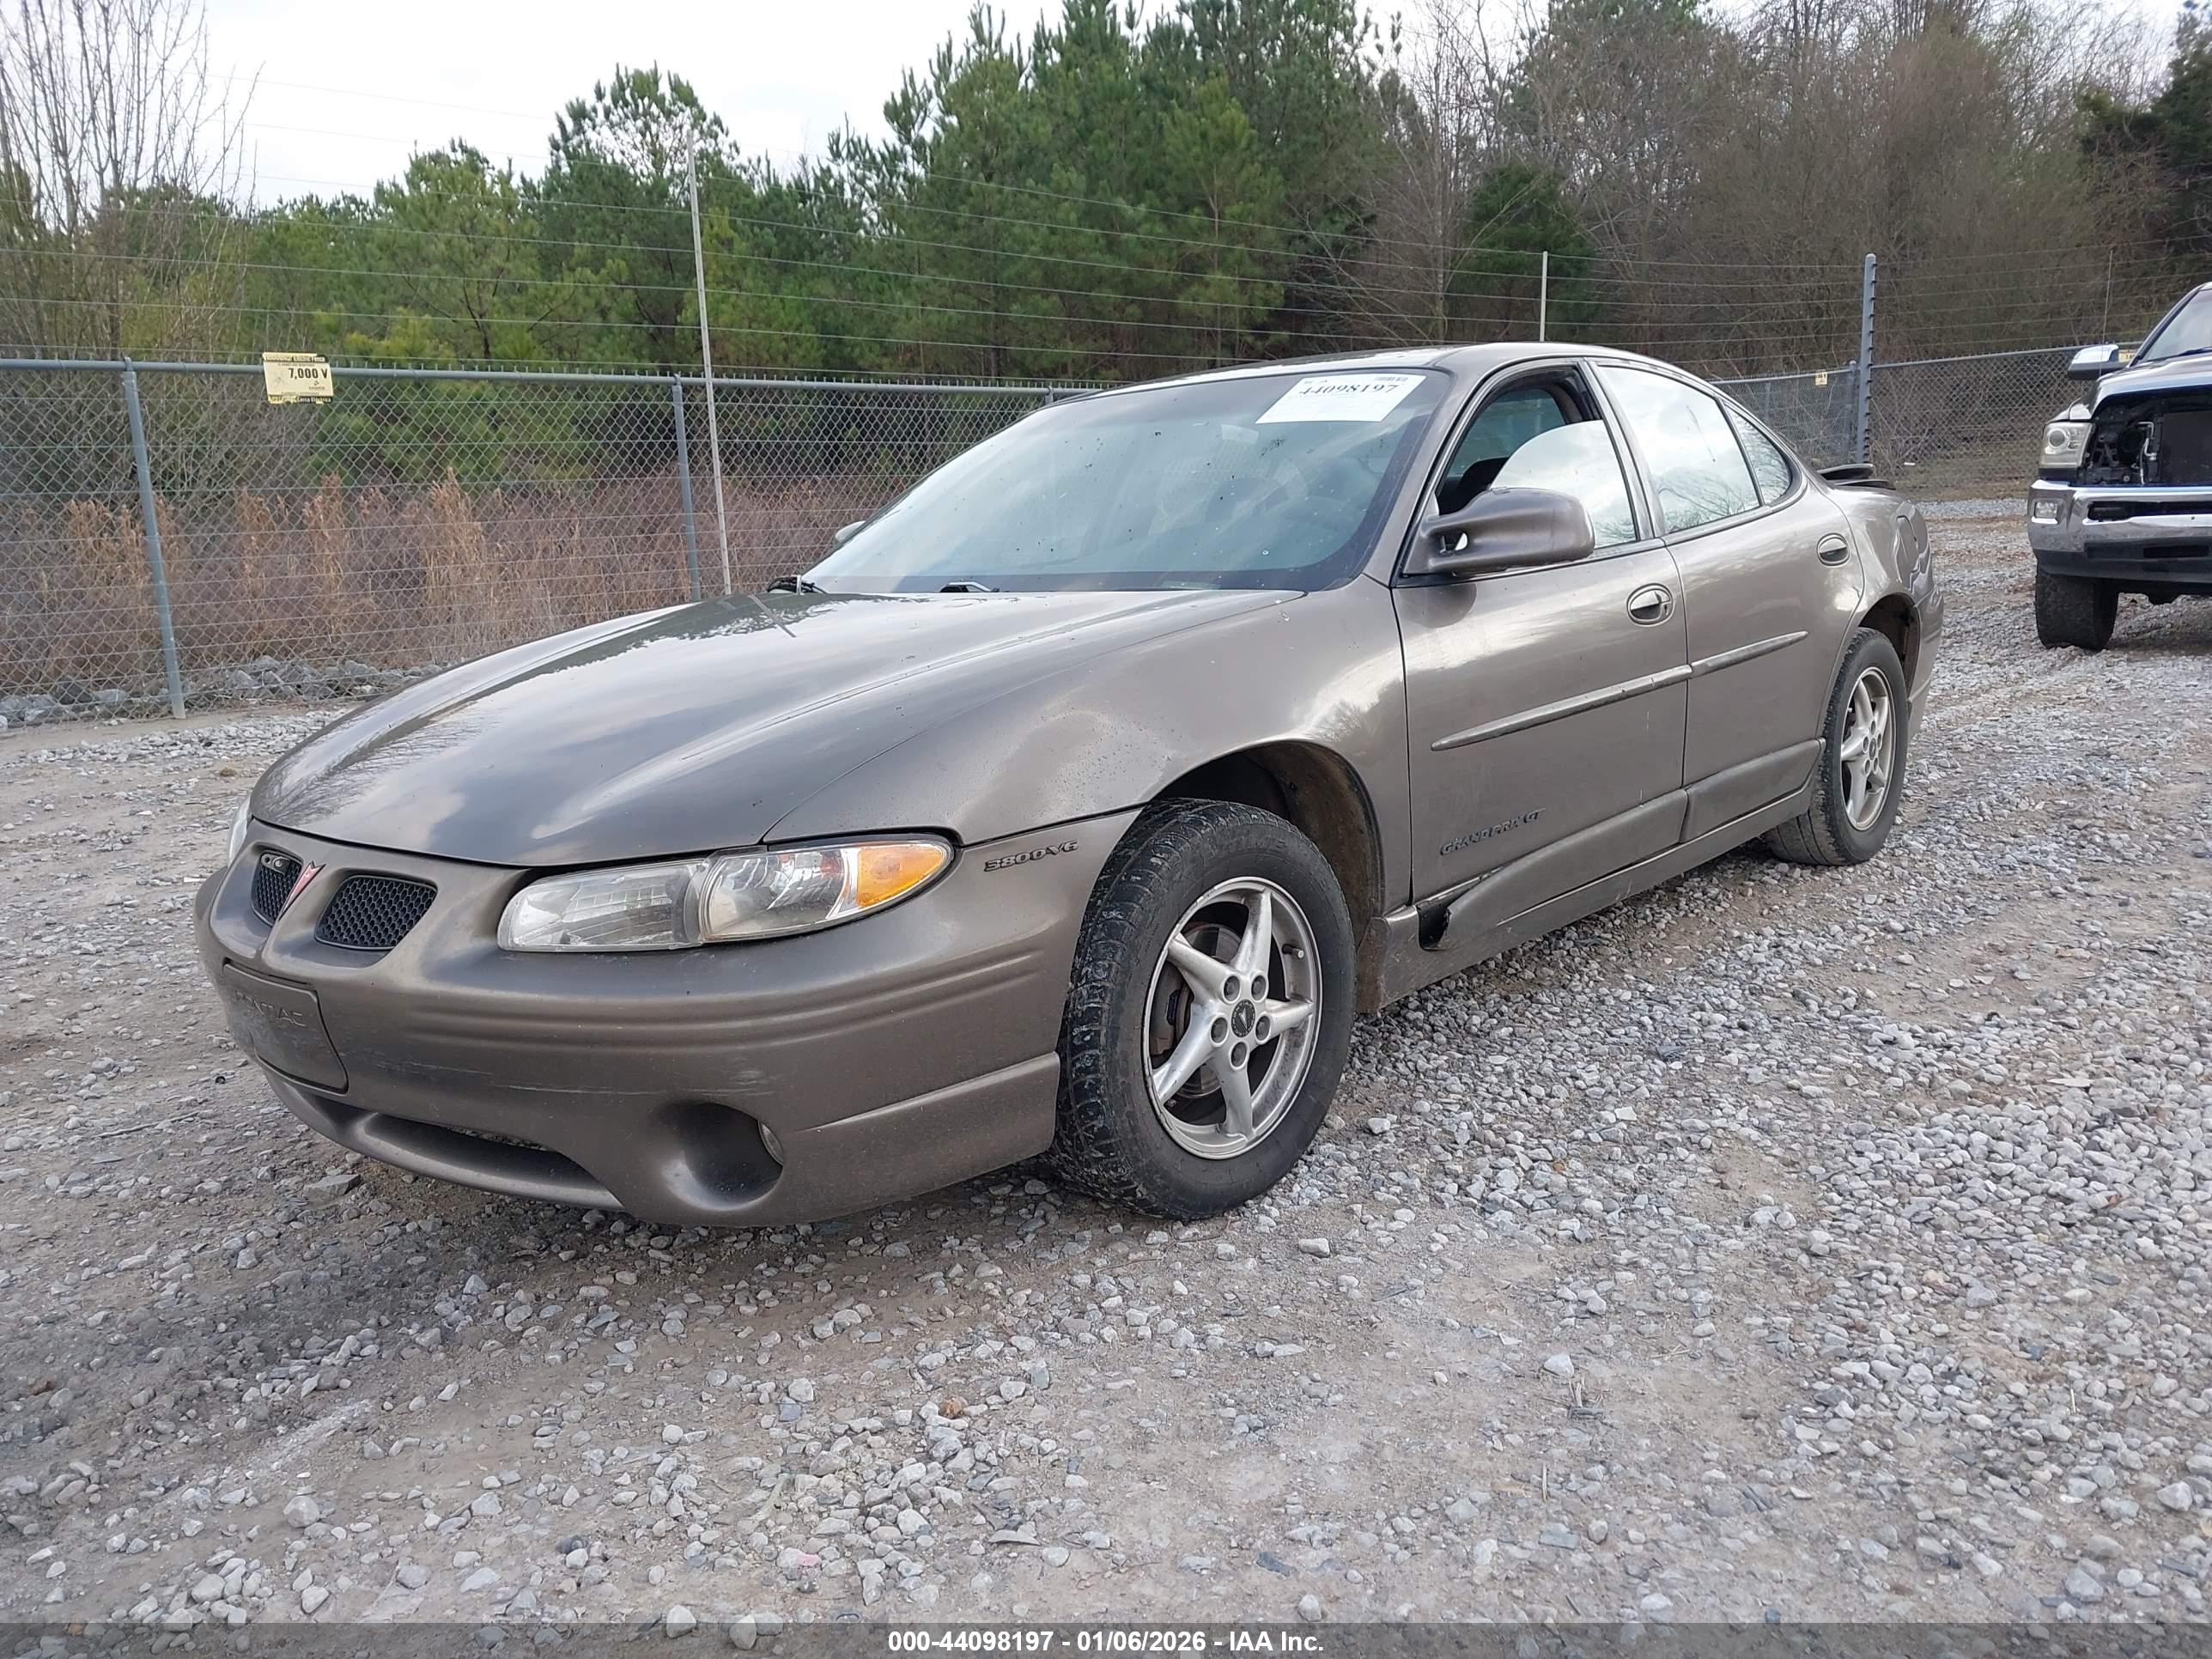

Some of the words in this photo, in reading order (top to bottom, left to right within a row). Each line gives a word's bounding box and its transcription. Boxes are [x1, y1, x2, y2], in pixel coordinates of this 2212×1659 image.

[289, 368, 319, 380] 7,000
[321, 368, 328, 379] V
[1298, 384, 1399, 395] 44098197
